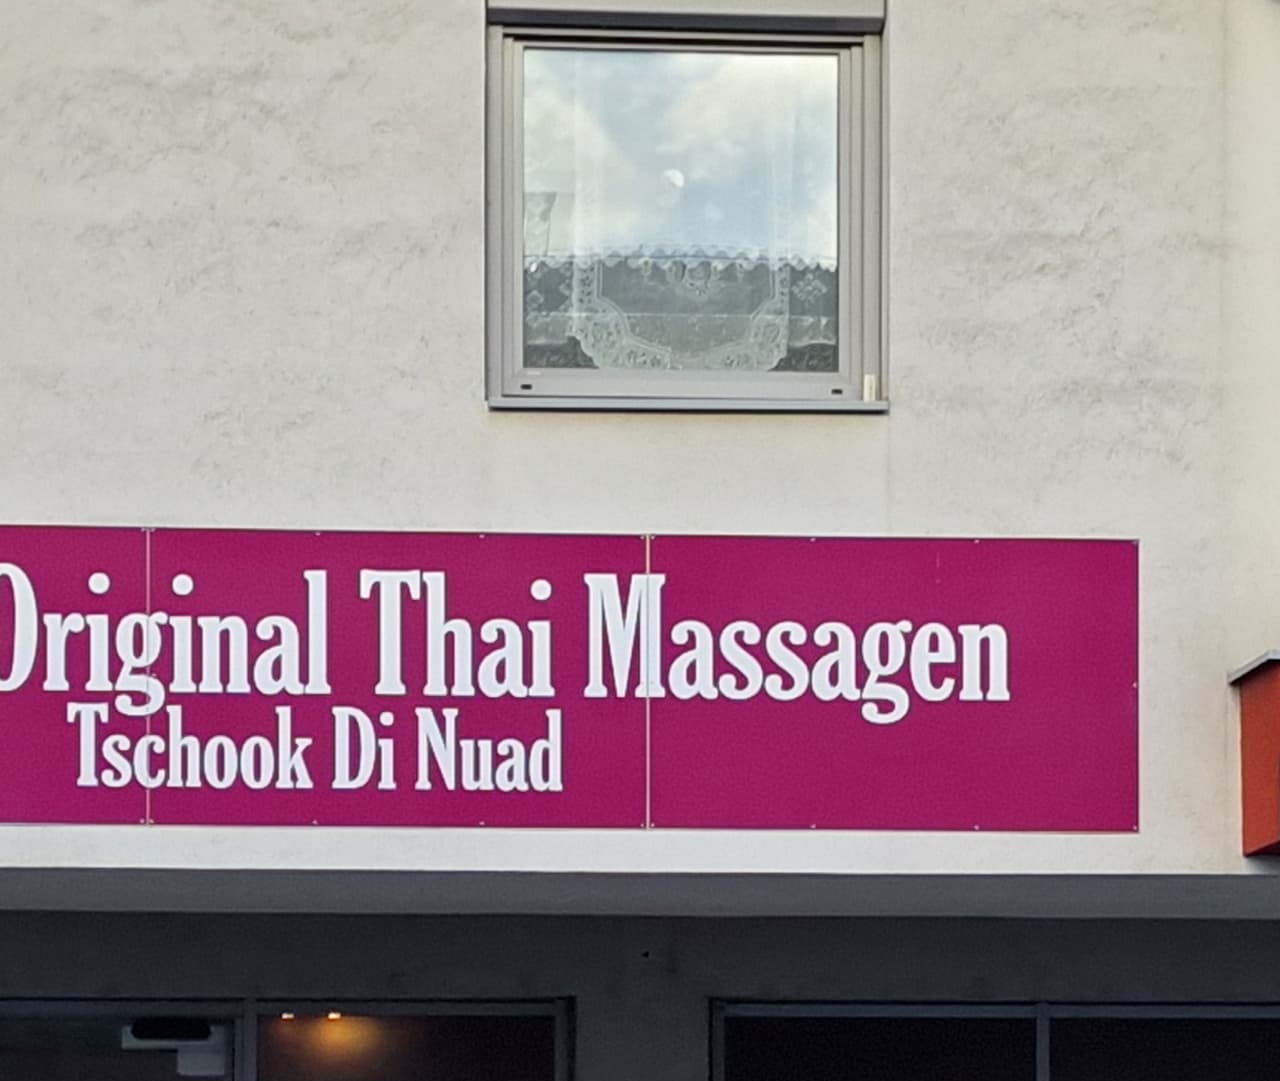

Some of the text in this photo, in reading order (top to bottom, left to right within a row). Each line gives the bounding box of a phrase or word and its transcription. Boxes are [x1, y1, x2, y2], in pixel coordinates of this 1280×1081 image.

[359, 569, 556, 698] Thai
[584, 574, 1011, 724] Massagen
[67, 702, 564, 793] Tschook Di Nuad
